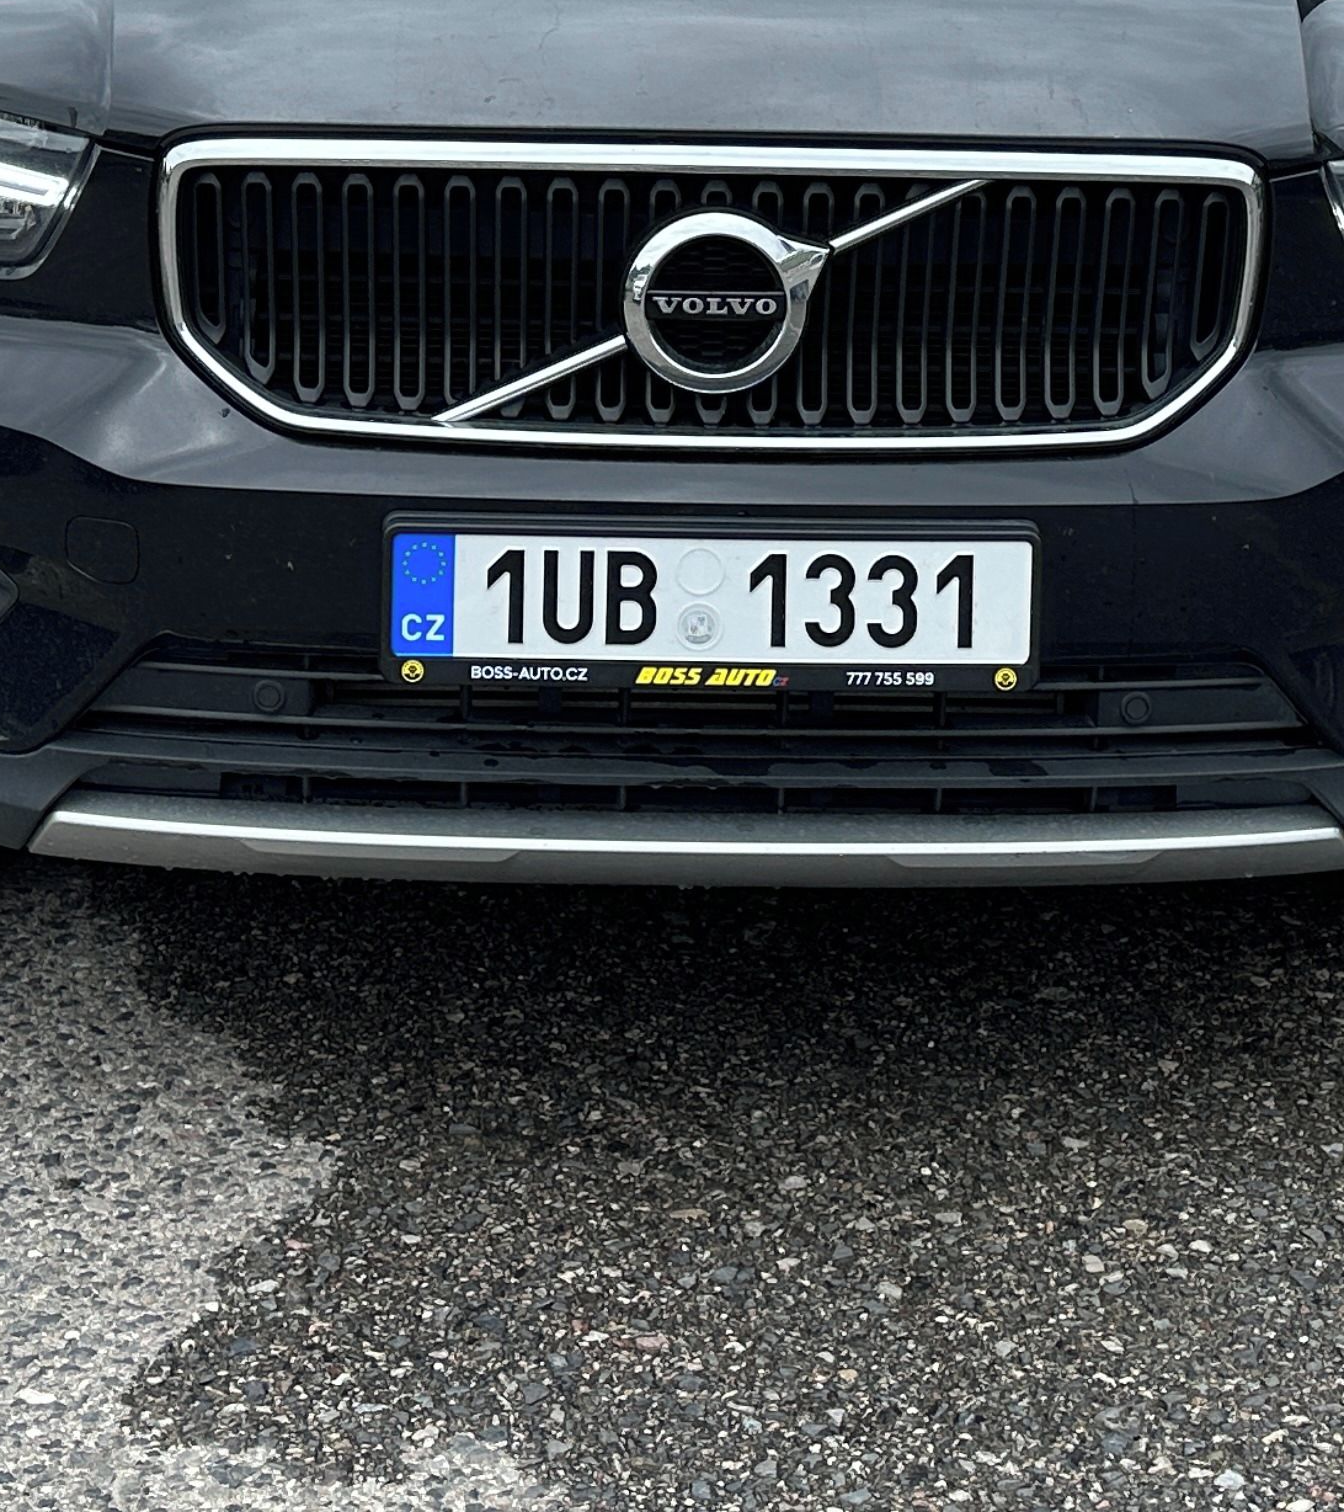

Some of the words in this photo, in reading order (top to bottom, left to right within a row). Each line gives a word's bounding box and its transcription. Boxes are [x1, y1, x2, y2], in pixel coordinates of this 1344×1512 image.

[652, 295, 777, 316] VOLVO
[487, 549, 657, 645] 1UB
[749, 553, 975, 648] 1331
[401, 613, 446, 642] CZ
[470, 665, 589, 682] BOSS-AUTO.CZ
[635, 666, 704, 686] BOSS
[705, 668, 778, 687] AUTO
[846, 671, 873, 686] 777
[874, 671, 903, 686] 755
[905, 672, 935, 686] 599
